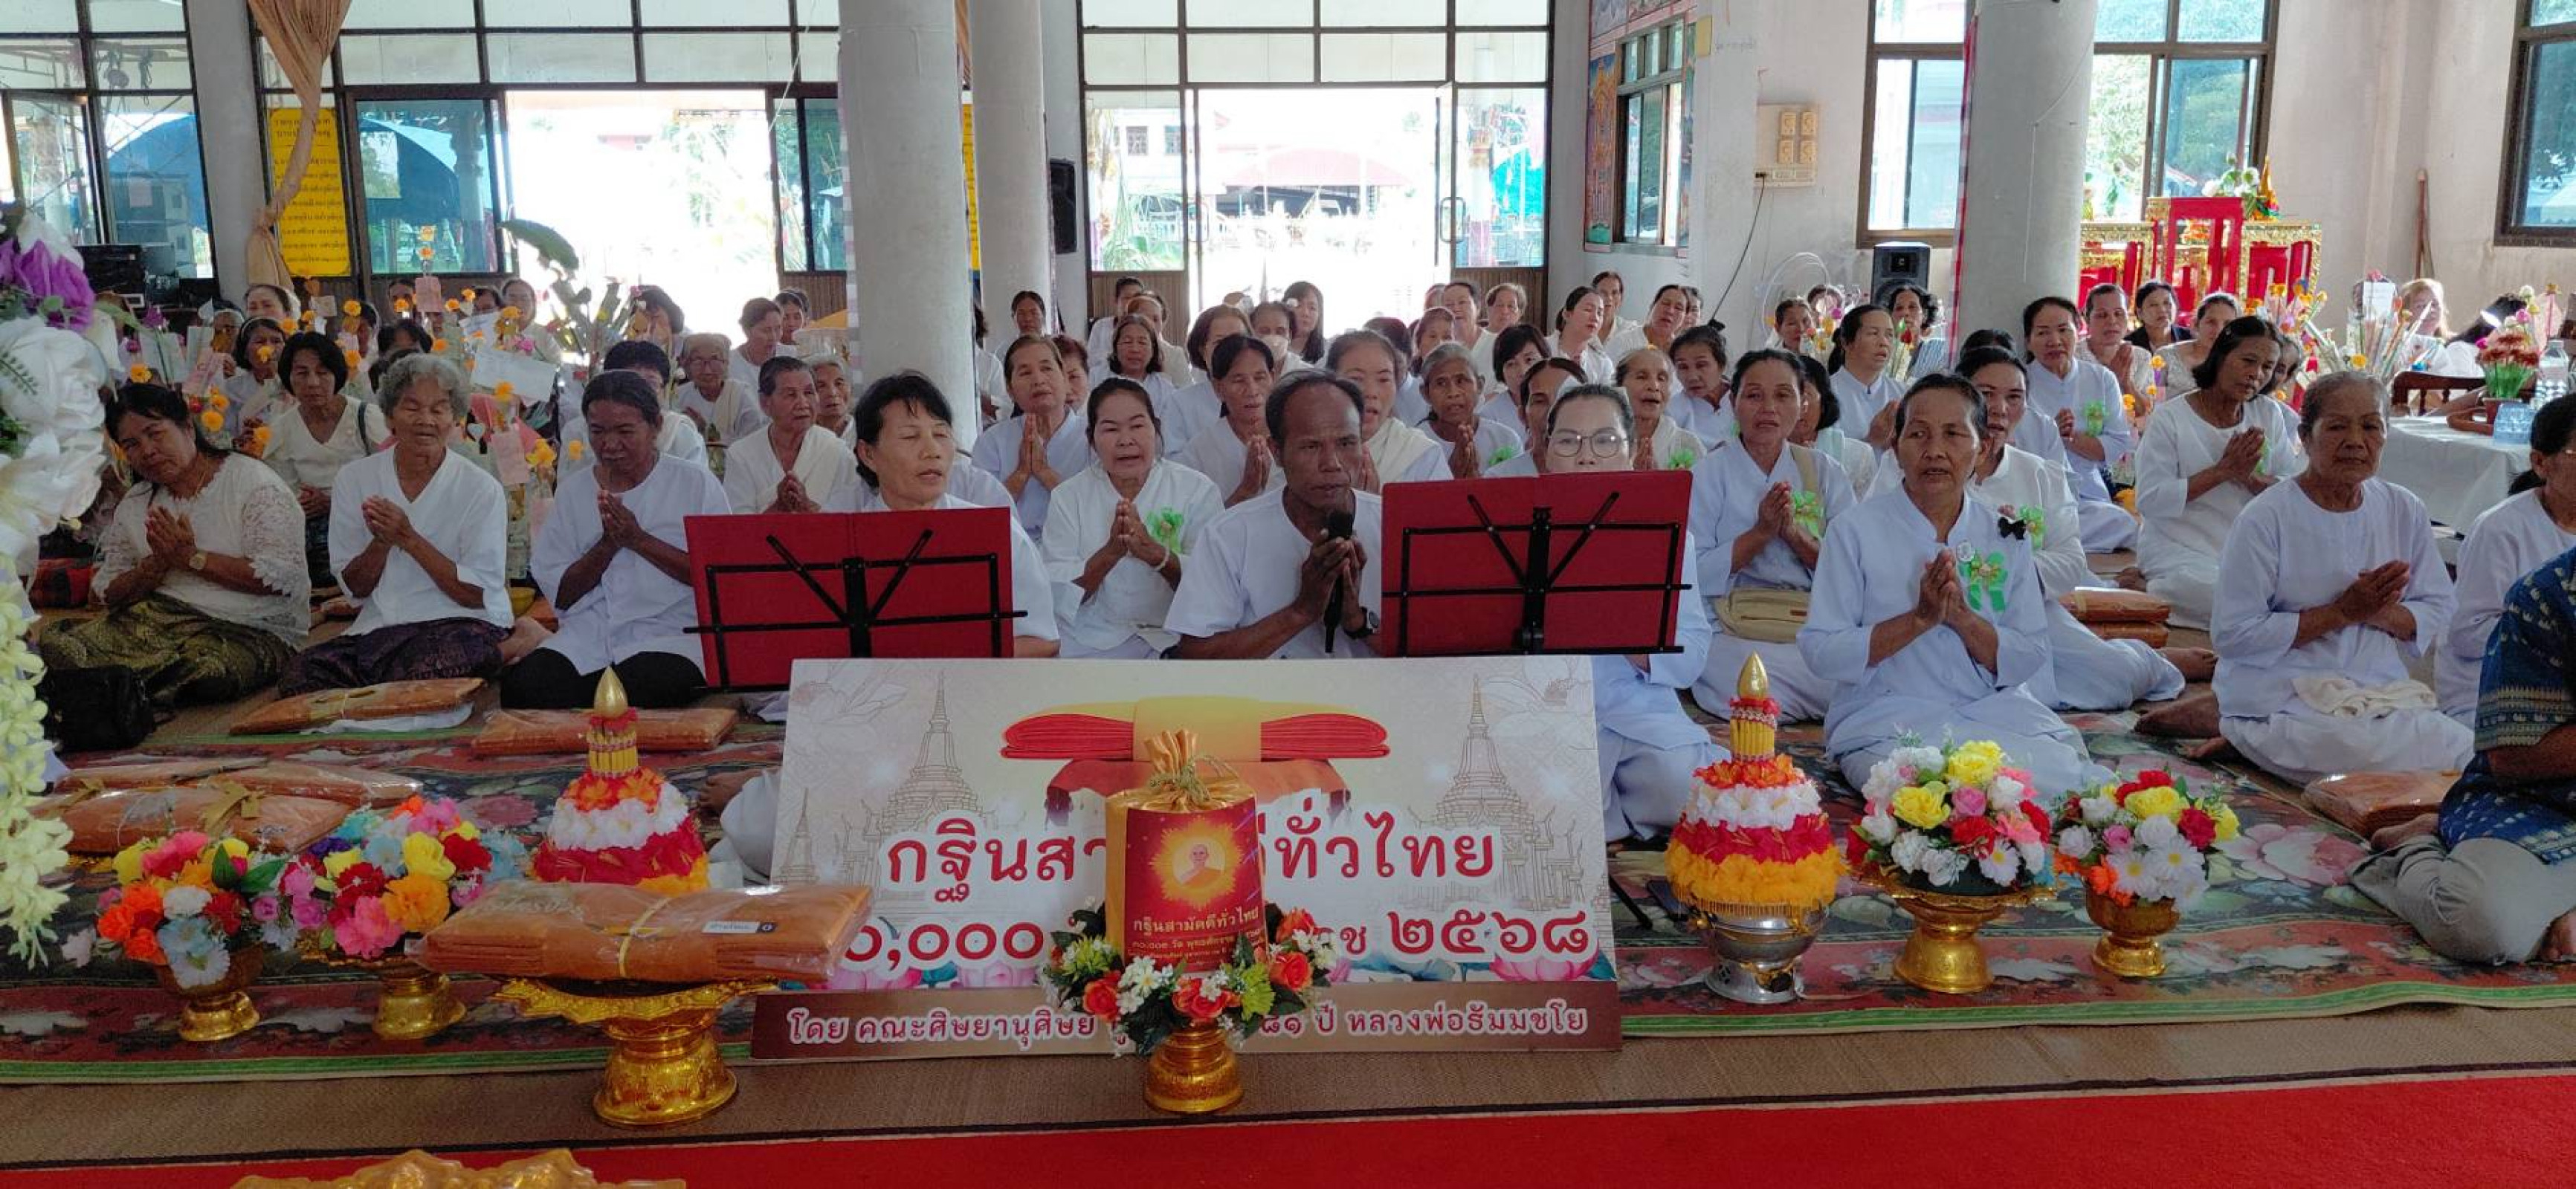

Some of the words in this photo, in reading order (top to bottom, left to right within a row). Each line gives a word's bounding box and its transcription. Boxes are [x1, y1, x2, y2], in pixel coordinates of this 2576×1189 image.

[888, 797, 1493, 902] กฐินสาทั่วไทย
[845, 922, 1043, 971] ๐,๐๐๐
[1387, 909, 1589, 954] ๒๕๖๘
[790, 1012, 845, 1040] โดย
[859, 1009, 1094, 1043] คณะศิษยานุศิษย
[1347, 1002, 1585, 1033] หลวงพ่อธัมมชโย
